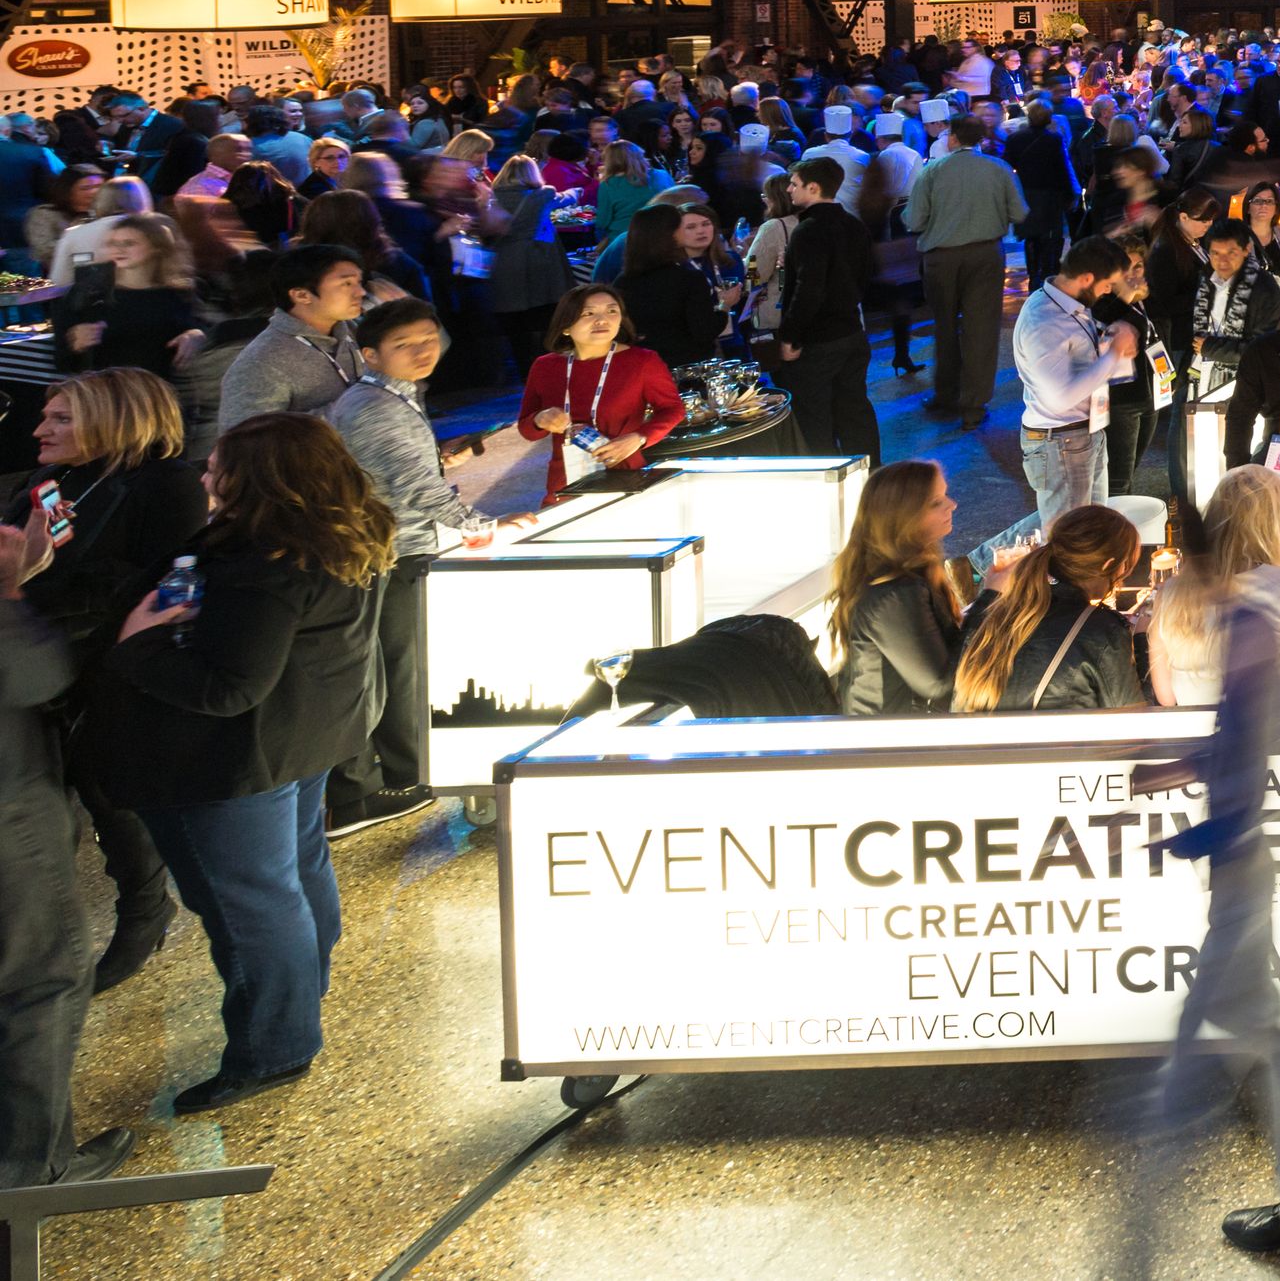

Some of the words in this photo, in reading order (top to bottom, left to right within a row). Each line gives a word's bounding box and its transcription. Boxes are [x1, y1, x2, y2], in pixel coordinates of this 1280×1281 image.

[1018, 14, 1031, 24] 51
[15, 47, 82, 70] Shaw's
[725, 899, 1123, 946] EVENTCREATIVE
[574, 1011, 1056, 1052] WWW.EVENTCREATIVE.COM
